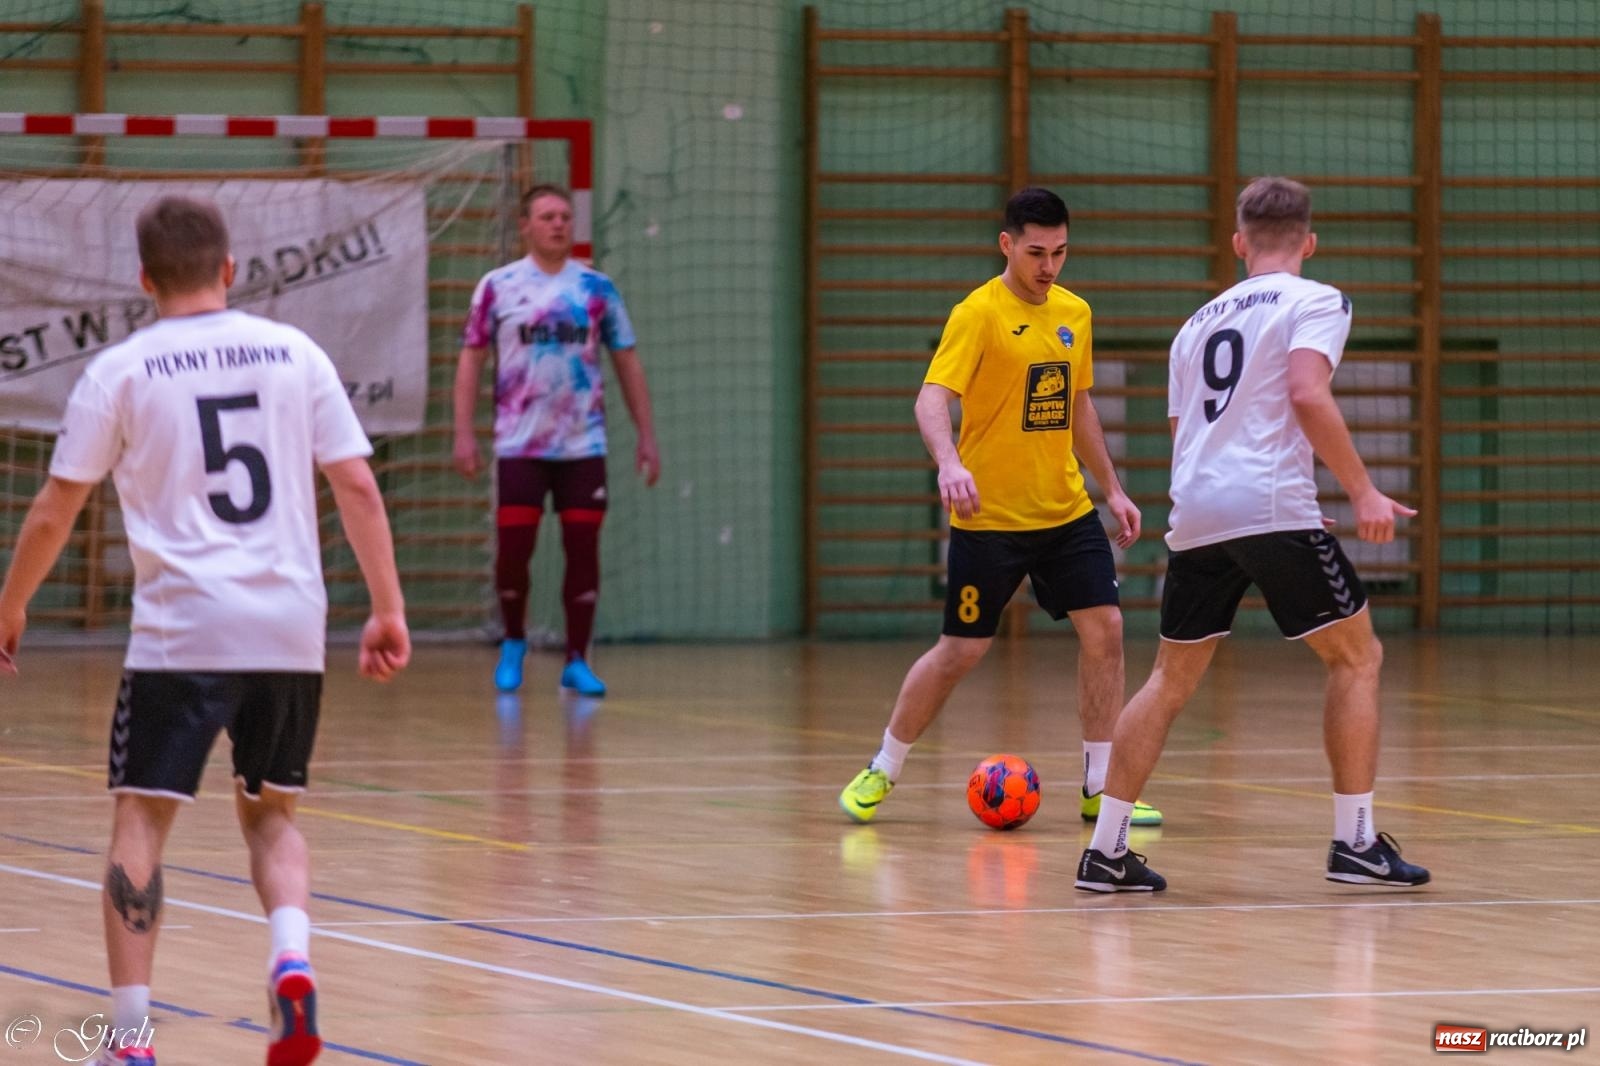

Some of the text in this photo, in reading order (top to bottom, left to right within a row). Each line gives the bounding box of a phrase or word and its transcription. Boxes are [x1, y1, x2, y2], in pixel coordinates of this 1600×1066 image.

[1203, 328, 1244, 424] 9
[196, 390, 272, 525] 5
[958, 585, 980, 624] 8
